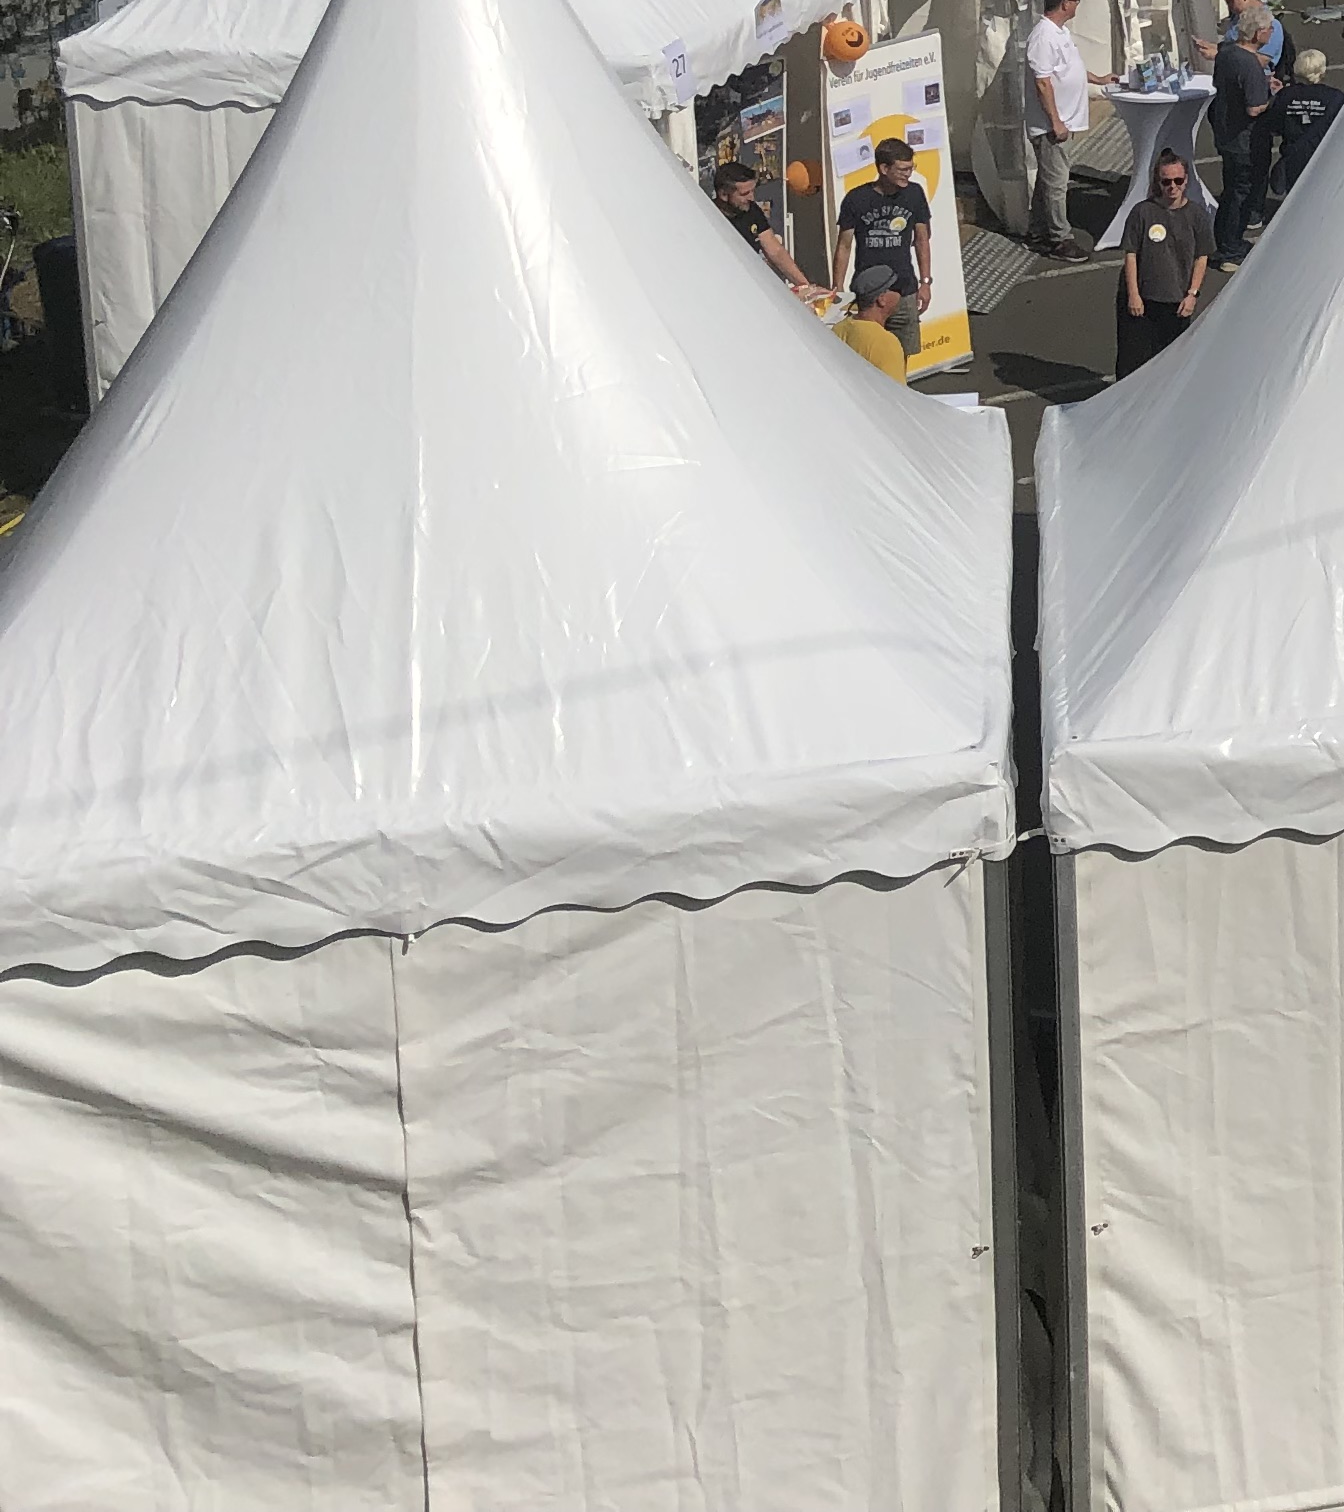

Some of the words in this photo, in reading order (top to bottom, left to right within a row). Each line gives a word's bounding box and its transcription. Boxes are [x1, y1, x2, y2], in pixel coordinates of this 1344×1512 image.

[671, 53, 687, 78] 27
[828, 74, 853, 89] Verein
[853, 69, 864, 83] für
[864, 56, 923, 81] Jugendfreizeiten
[923, 51, 937, 65] e.V.
[921, 335, 951, 350] ier.de
